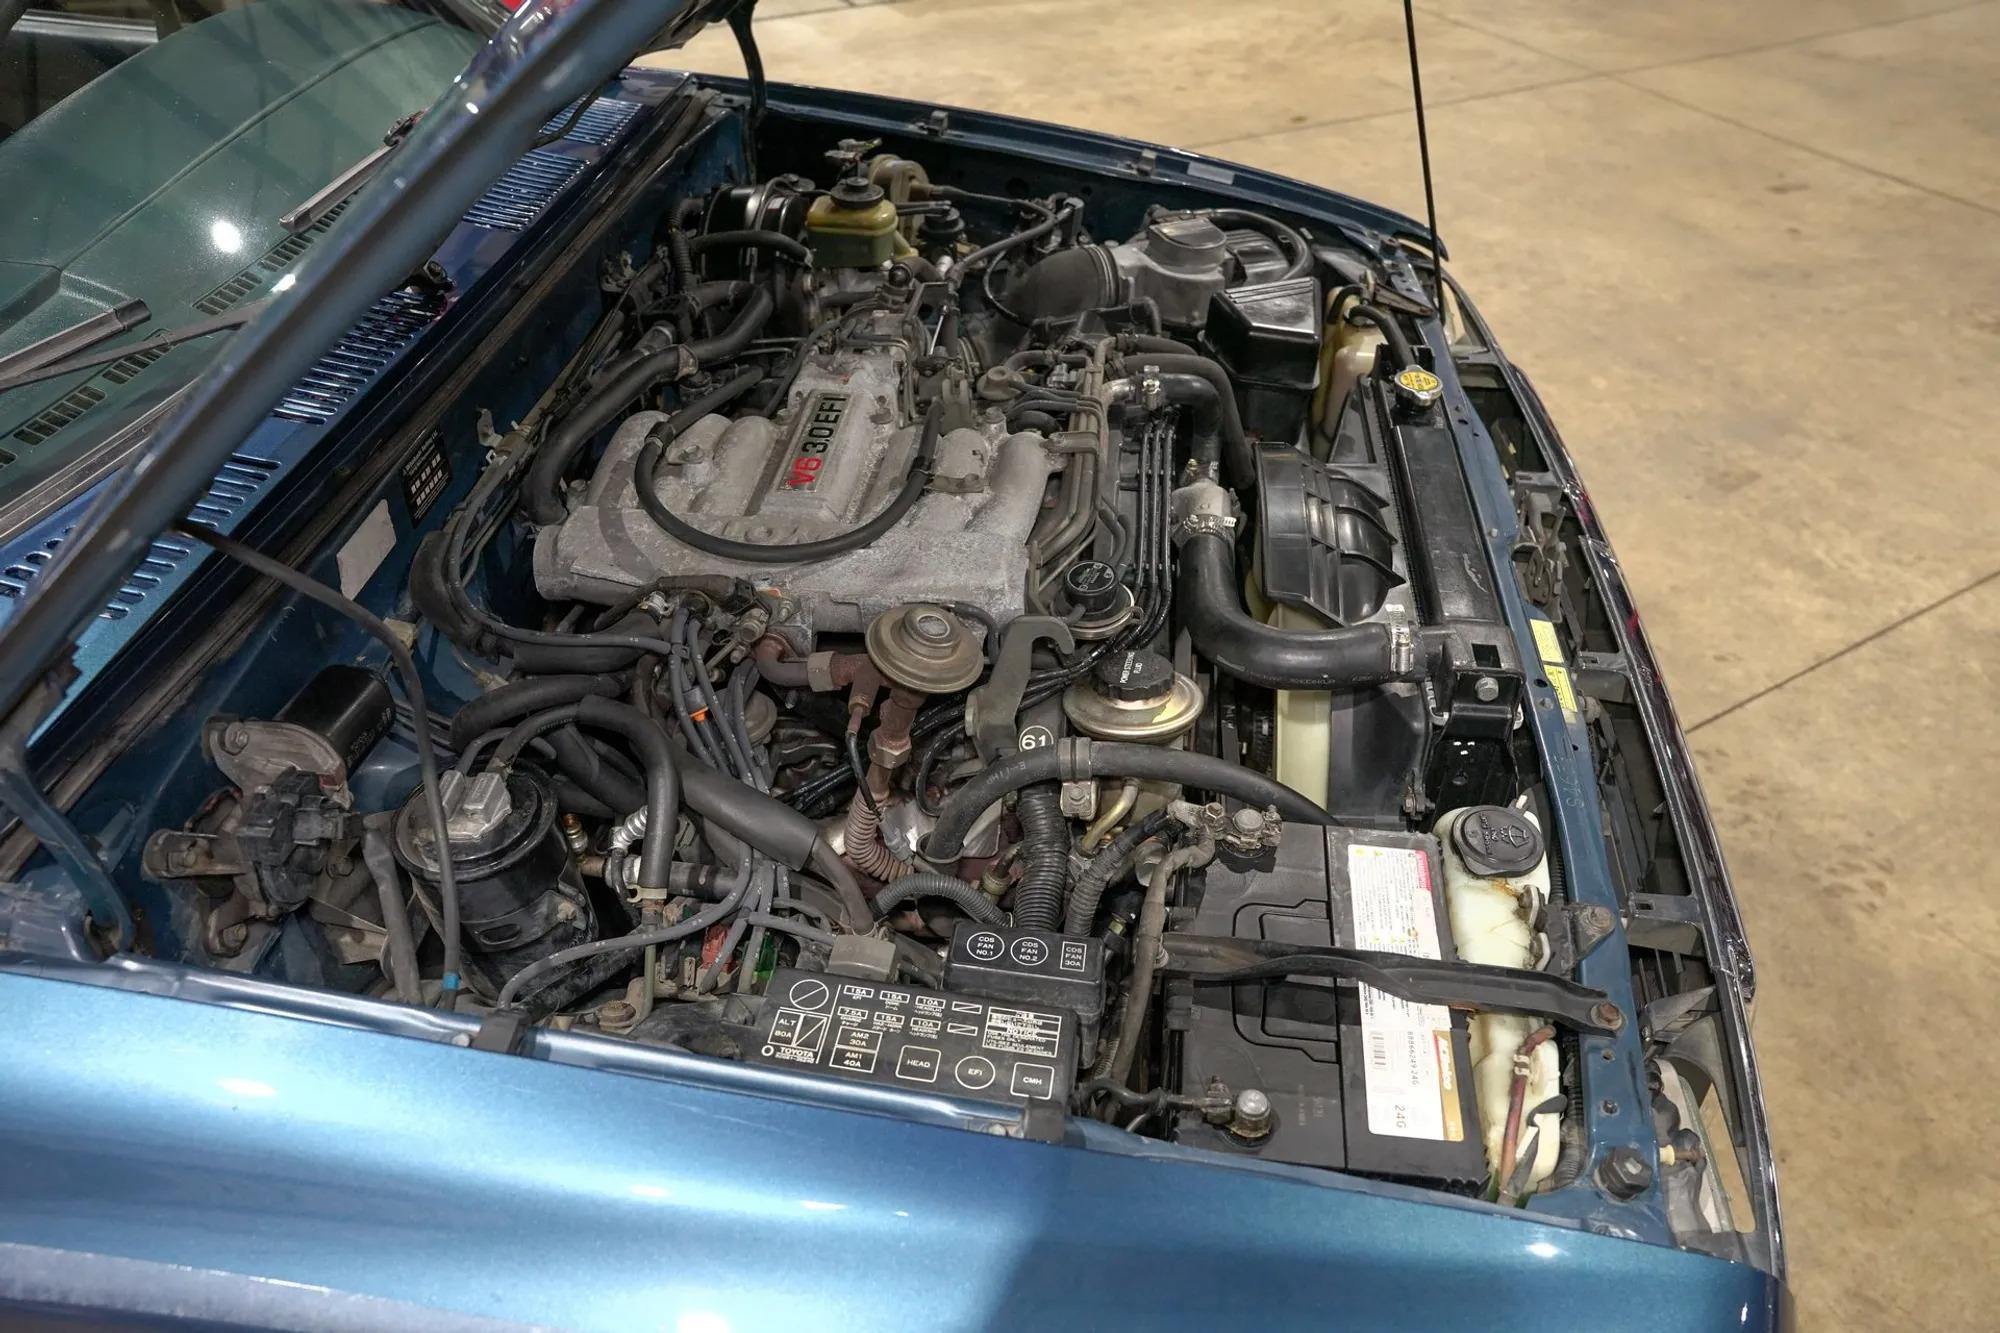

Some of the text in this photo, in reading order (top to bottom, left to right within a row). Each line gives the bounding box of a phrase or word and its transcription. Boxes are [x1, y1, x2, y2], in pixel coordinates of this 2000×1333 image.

[788, 457, 822, 486] V6
[1022, 735, 1045, 749] 61
[780, 1047, 814, 1058] TOYOTA
[906, 1059, 930, 1068] HEAD
[968, 1068, 982, 1076] EFI
[1022, 1076, 1042, 1085] CMH
